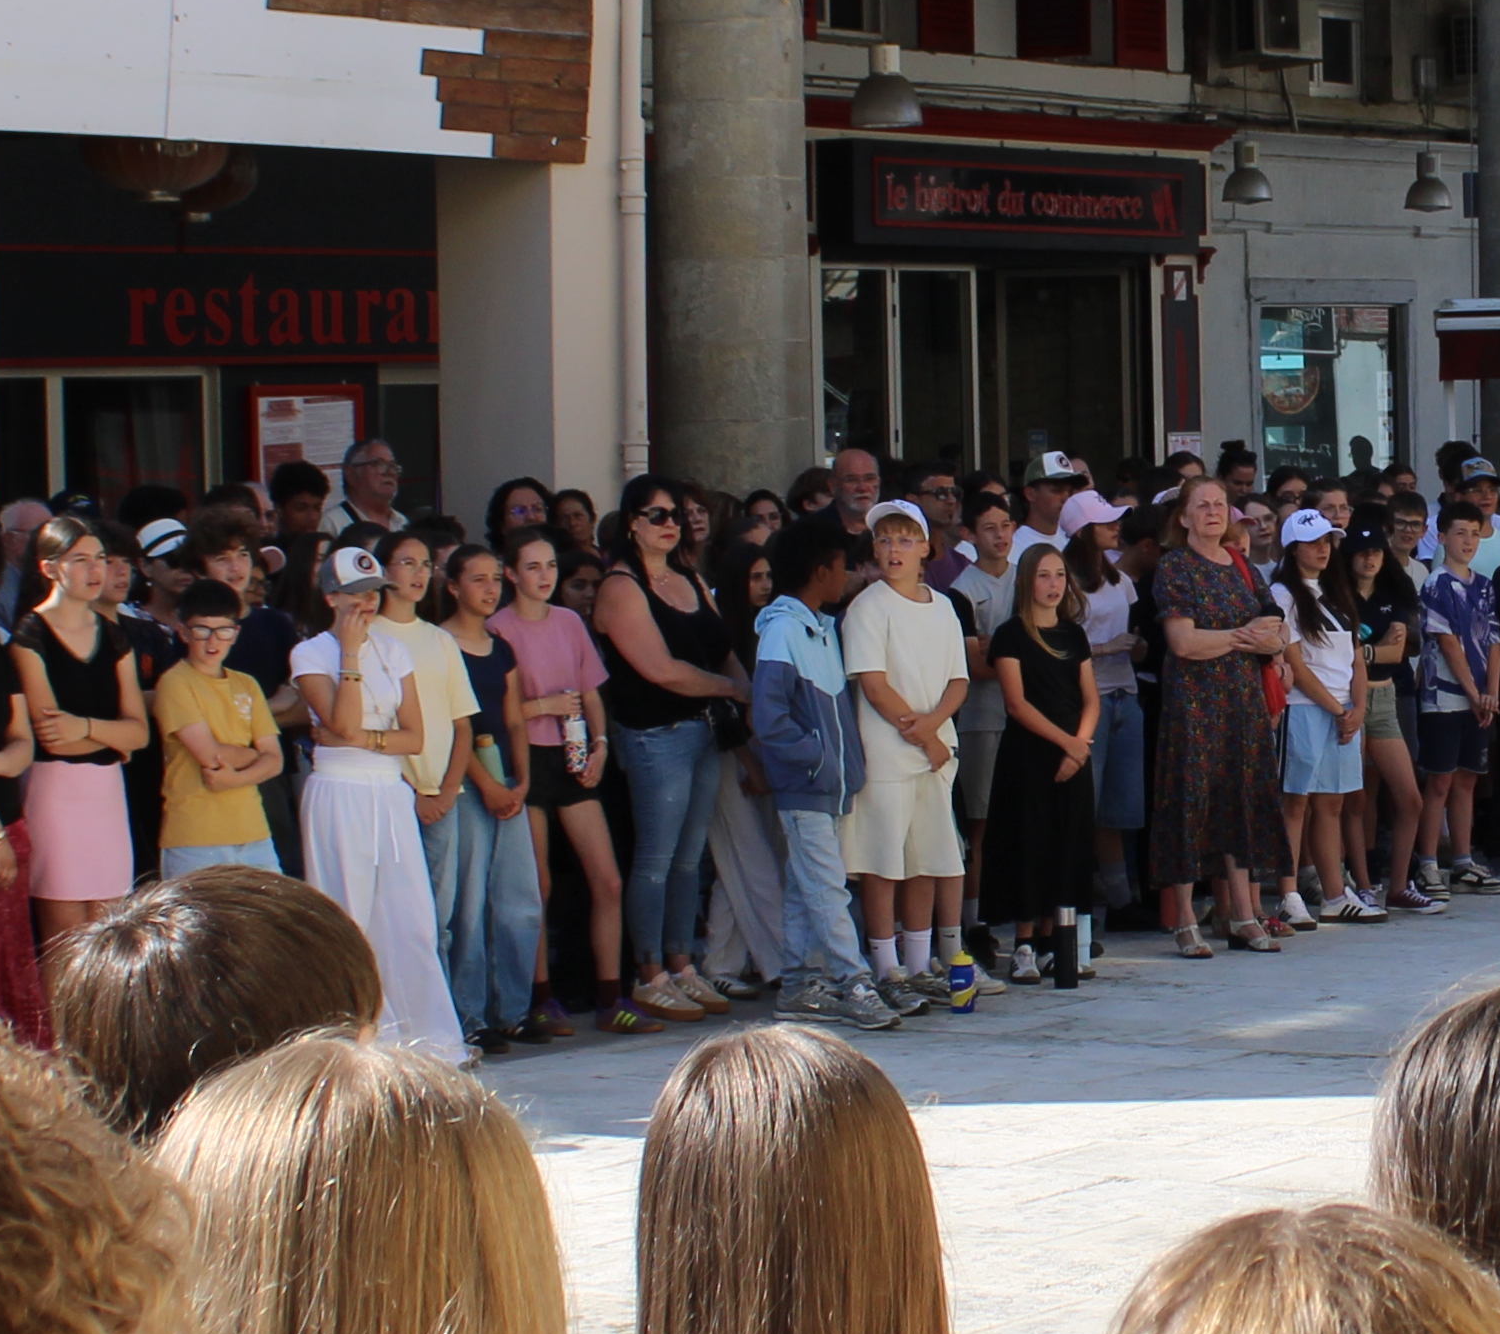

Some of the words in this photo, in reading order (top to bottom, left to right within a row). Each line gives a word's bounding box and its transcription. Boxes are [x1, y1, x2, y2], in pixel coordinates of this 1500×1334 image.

[886, 173, 907, 211] le
[915, 173, 990, 215] bistrot
[997, 179, 1025, 216] du
[1032, 189, 1143, 219] commerce
